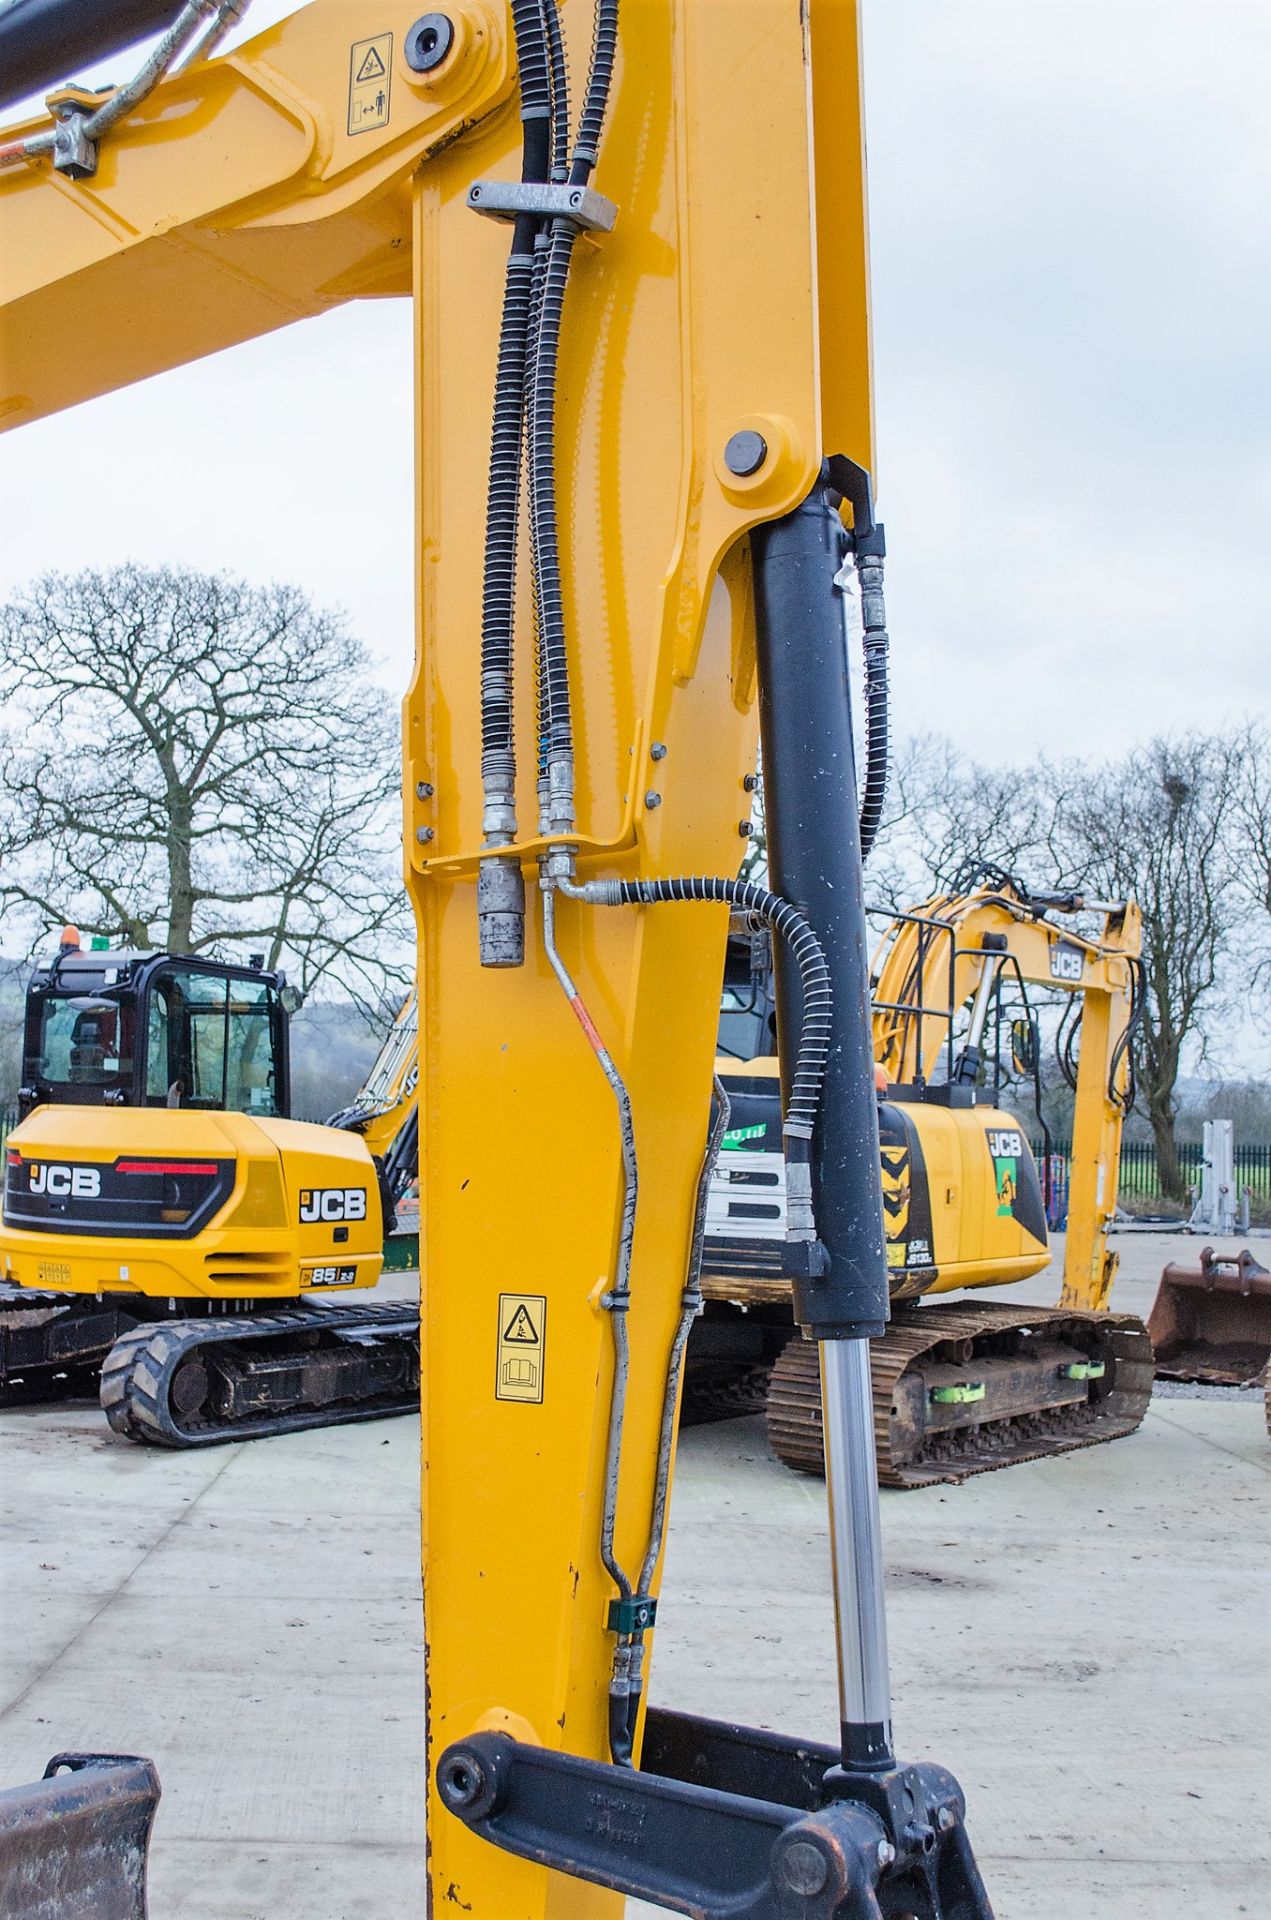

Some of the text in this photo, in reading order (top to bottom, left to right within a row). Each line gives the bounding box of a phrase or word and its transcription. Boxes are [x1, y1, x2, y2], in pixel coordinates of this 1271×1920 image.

[1051, 951, 1082, 979] JCB
[989, 1133, 1022, 1157] JCB
[29, 1164, 101, 1198] JCB
[300, 1189, 366, 1222] JCB
[312, 1267, 337, 1283] 85
